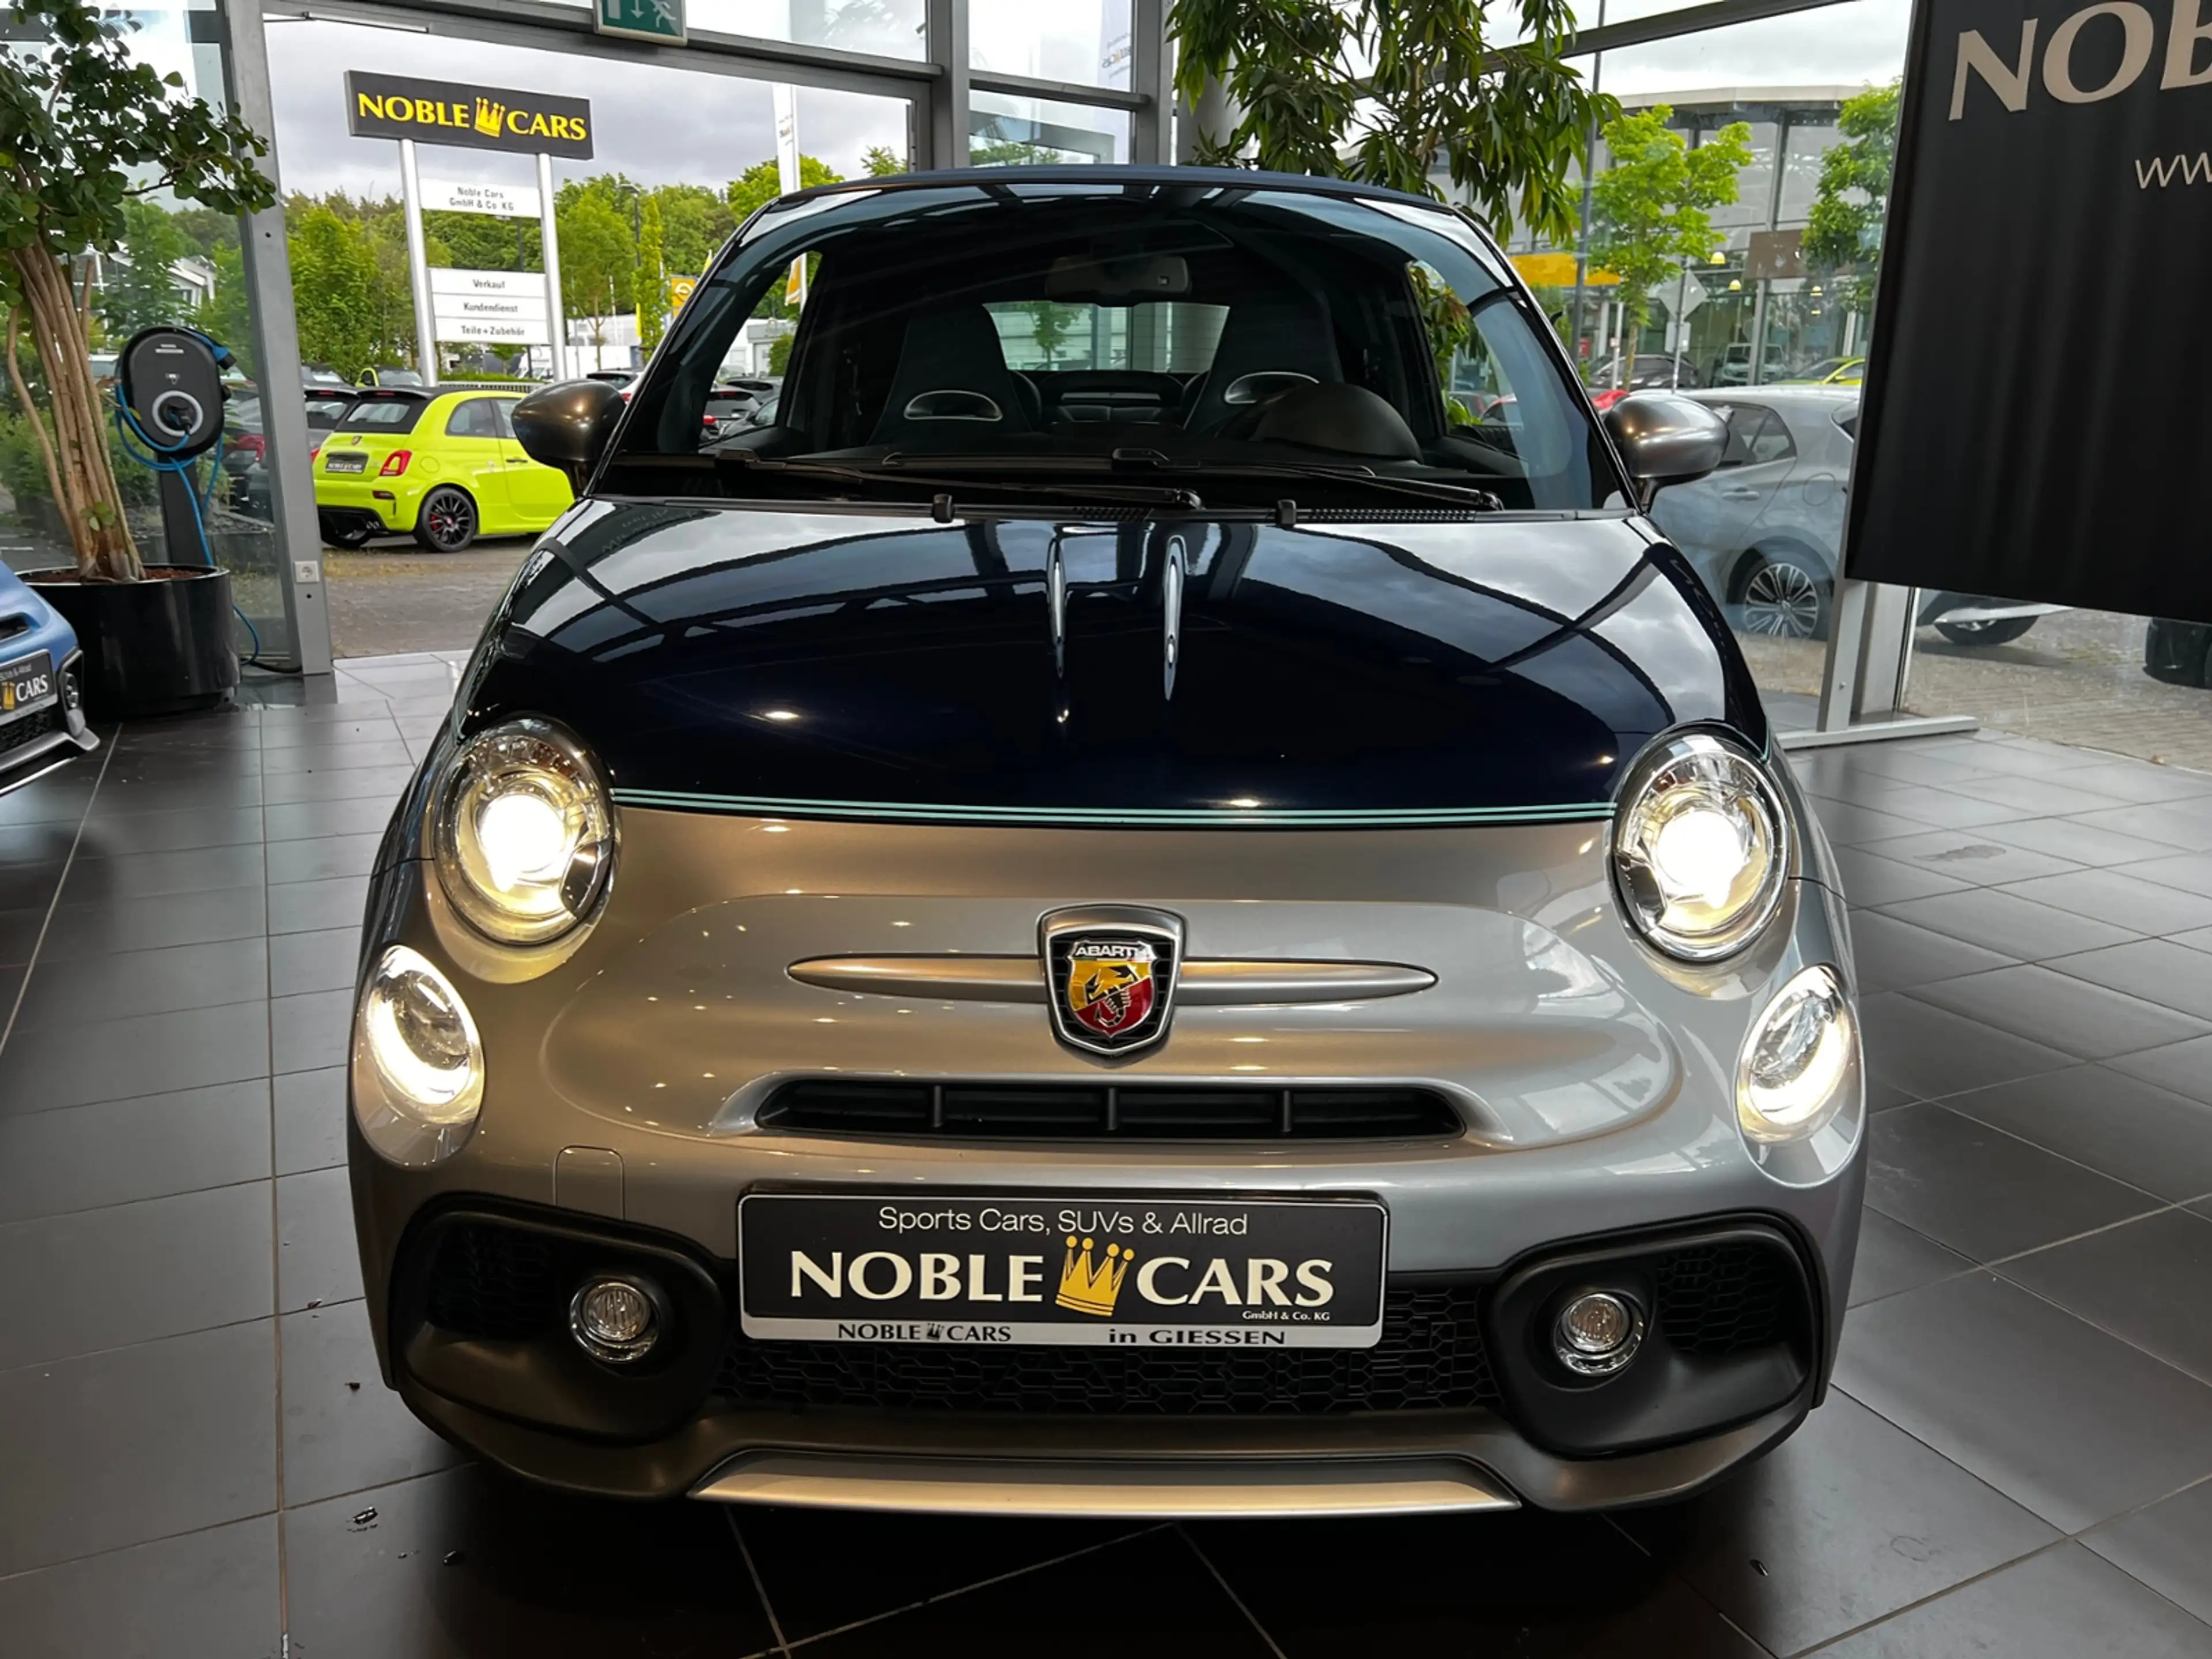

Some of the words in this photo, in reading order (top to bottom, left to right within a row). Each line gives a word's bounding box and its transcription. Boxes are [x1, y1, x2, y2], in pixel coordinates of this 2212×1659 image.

[357, 92, 470, 128] NOBLE
[506, 110, 588, 141] CARS
[457, 186, 481, 196] Noble
[484, 189, 504, 198] Cars
[472, 279, 506, 289] Verkauf
[463, 301, 518, 313] Kundendienst
[461, 324, 482, 334] Teile
[16, 674, 48, 702] CARS
[1075, 945, 1150, 957] ABART
[878, 1207, 971, 1233] Sports
[980, 1208, 1051, 1235] Cars,
[1058, 1209, 1134, 1233] SUVs
[1142, 1211, 1164, 1234] &
[1170, 1212, 1248, 1235] Allrad
[791, 1251, 1044, 1302] NOBLE
[1137, 1256, 1334, 1307] CARS
[1242, 1310, 1278, 1320] GmbH
[1280, 1312, 1290, 1320] &
[1292, 1311, 1312, 1321] Co.
[1313, 1311, 1331, 1321] KG
[838, 1323, 921, 1340] NOBLE
[947, 1325, 1012, 1342] CARS
[1109, 1328, 1137, 1343] in
[1149, 1330, 1285, 1344] GIESSEN
